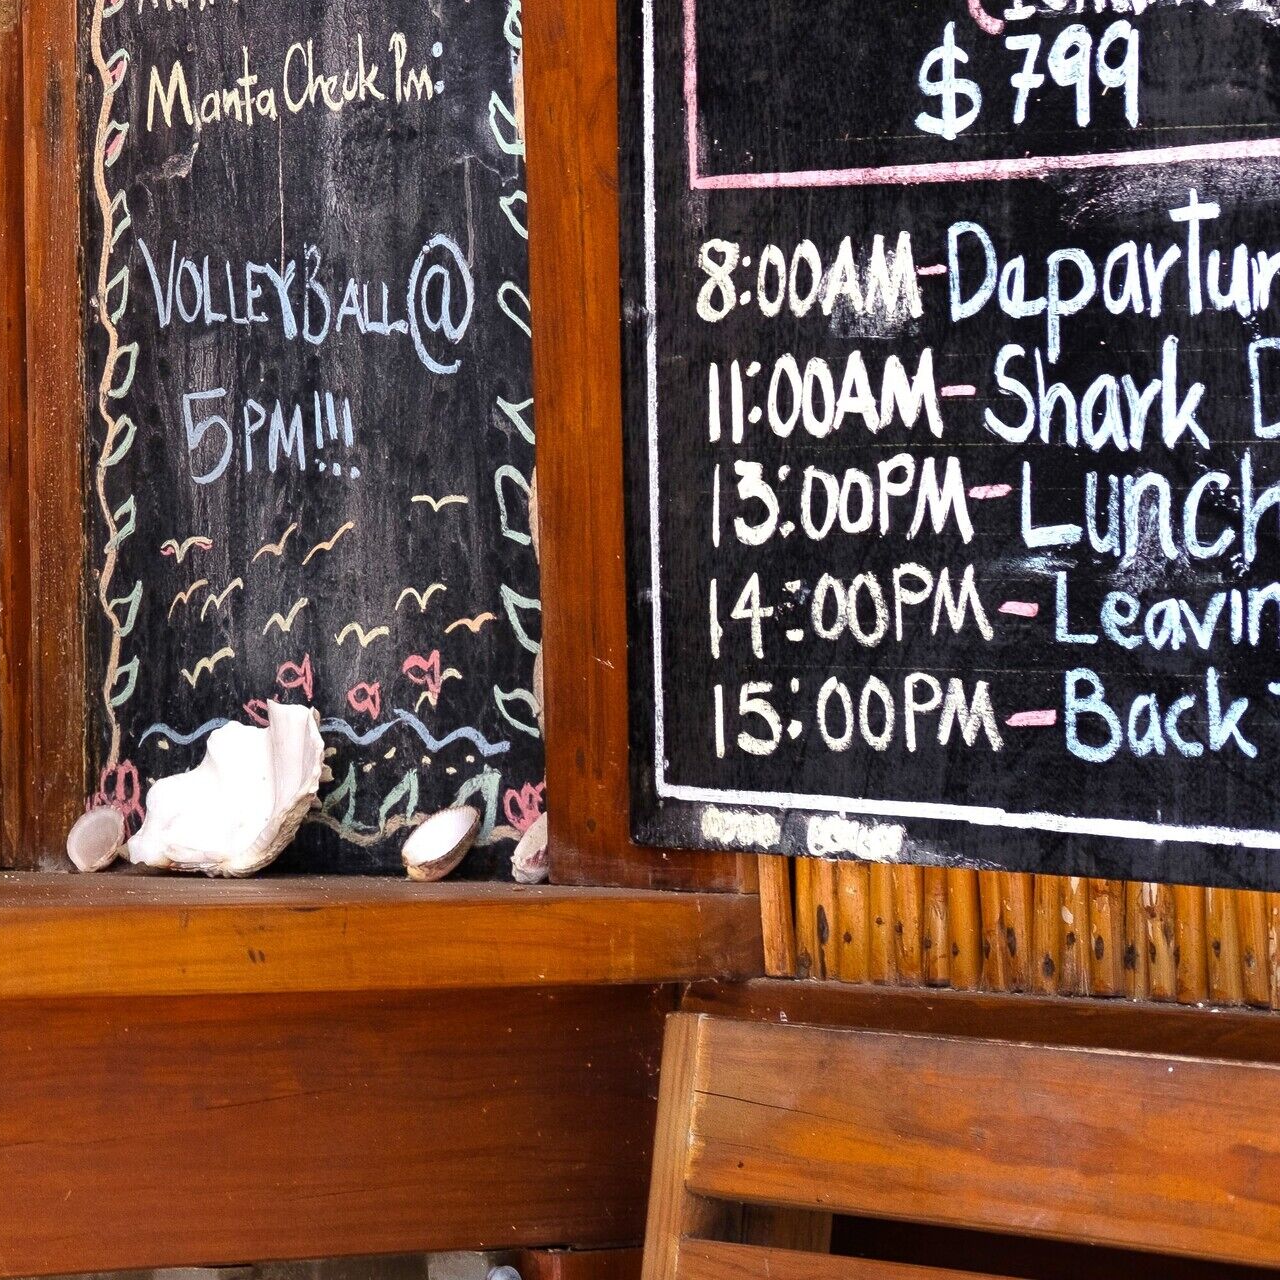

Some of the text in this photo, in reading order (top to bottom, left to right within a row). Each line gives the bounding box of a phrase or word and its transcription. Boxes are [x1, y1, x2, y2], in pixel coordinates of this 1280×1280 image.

[146, 45, 279, 132] Manta
[282, 32, 388, 112] Check
[914, 20, 1140, 140] $799
[984, 335, 1211, 450] Shark
[1063, 665, 1258, 763] Back
